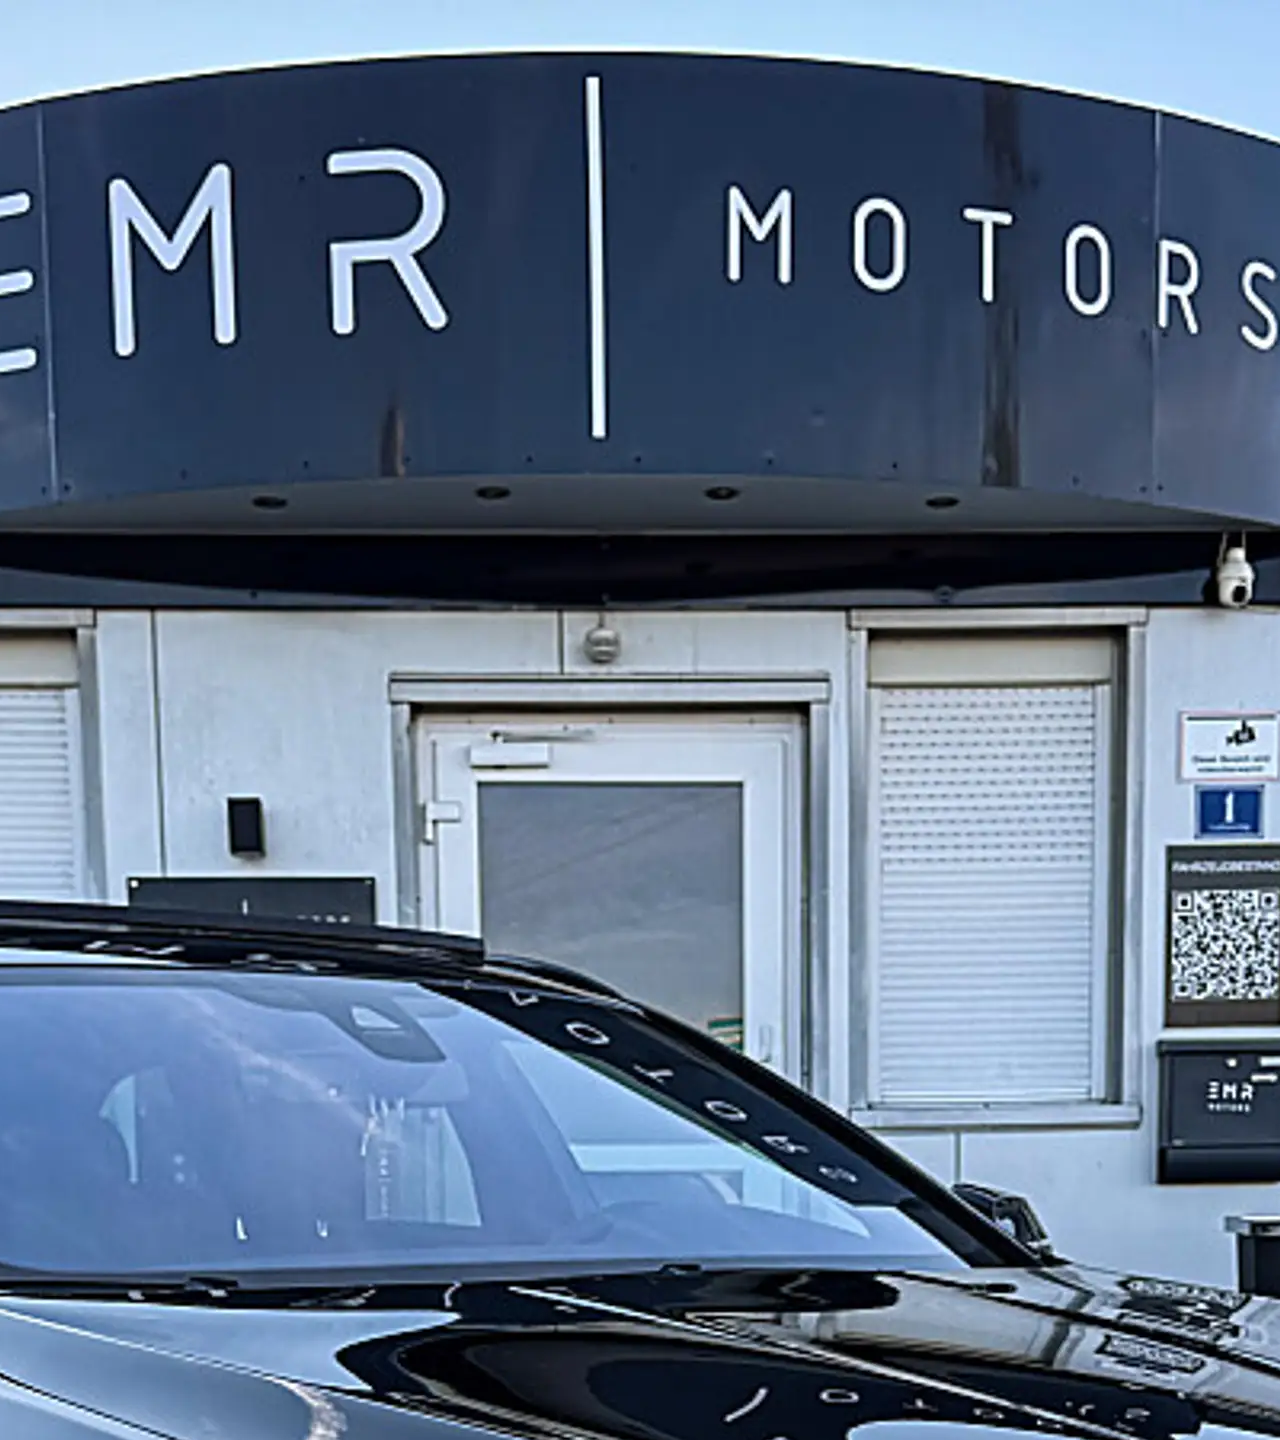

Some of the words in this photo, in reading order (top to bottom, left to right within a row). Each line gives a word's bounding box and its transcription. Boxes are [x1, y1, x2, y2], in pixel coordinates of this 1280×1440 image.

[727, 184, 1280, 351] MOTORS
[1225, 791, 1235, 823] 1
[1206, 1081, 1254, 1100] EMR
